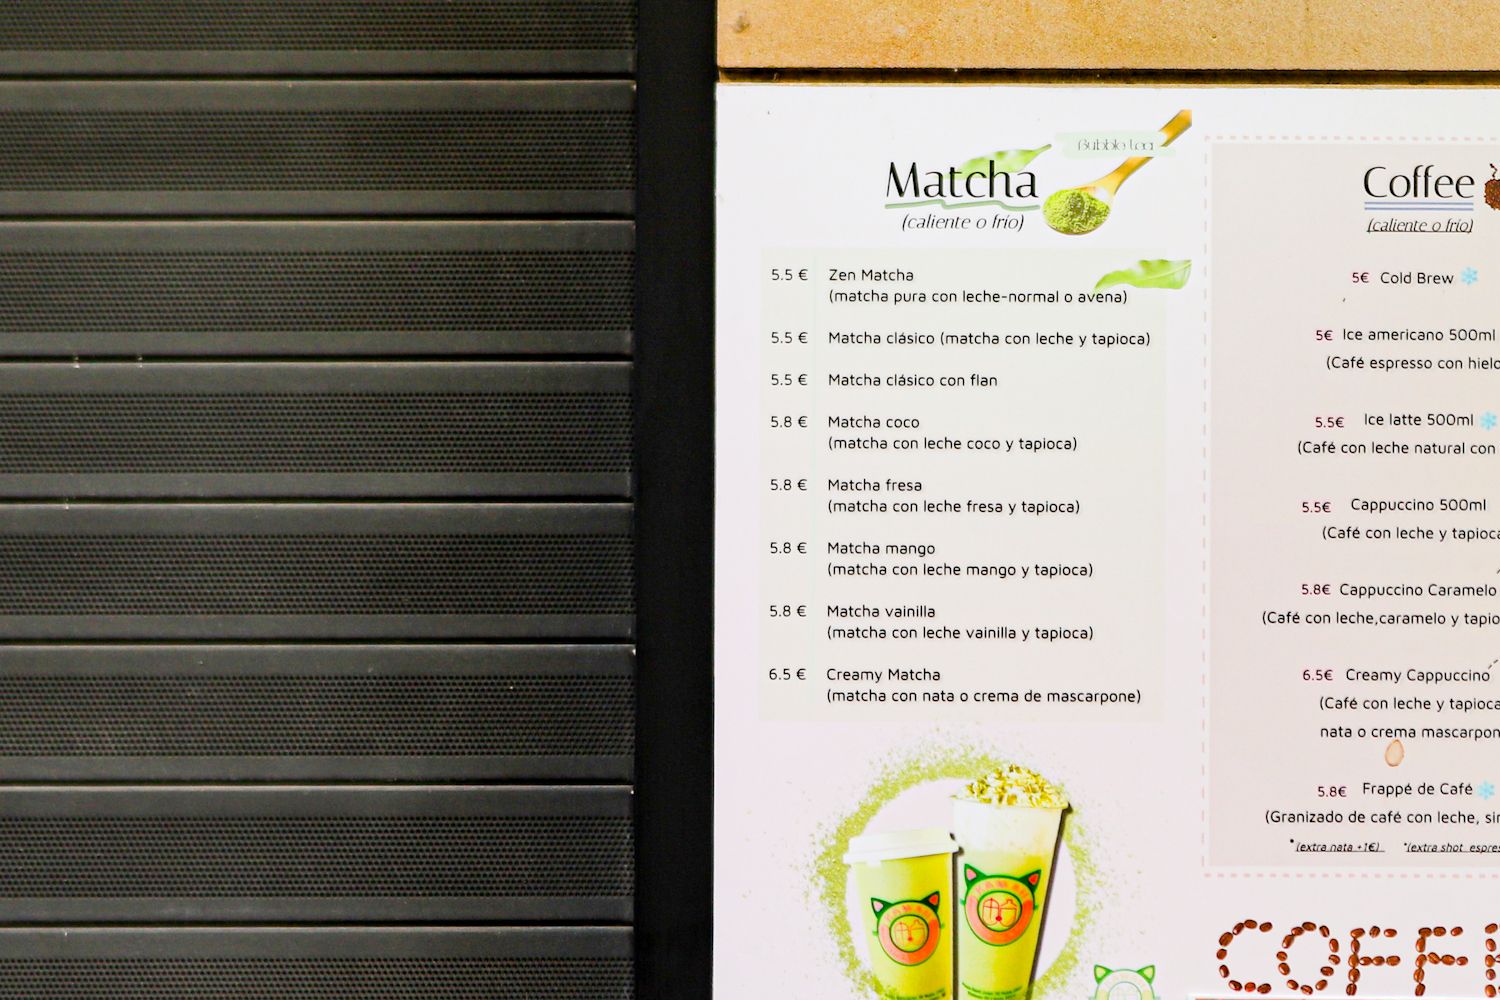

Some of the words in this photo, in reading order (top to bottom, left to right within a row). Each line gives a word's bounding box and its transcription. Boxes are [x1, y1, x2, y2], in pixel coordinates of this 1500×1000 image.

[886, 158, 1039, 199] Matcha
[1363, 164, 1475, 199] Coffee
[902, 213, 971, 232] (caliente
[975, 218, 987, 229] o
[991, 214, 1025, 232] frío)
[1366, 217, 1428, 233] (caliente
[1431, 222, 1442, 232] o
[1444, 217, 1474, 233] frío)
[771, 268, 793, 281] 5.5
[797, 268, 809, 281] €
[829, 268, 856, 282] Zen
[861, 268, 914, 282] Matcha
[1352, 271, 1369, 284] 5€
[1380, 271, 1412, 285] Cold
[1417, 272, 1454, 285] Brew
[829, 289, 889, 303] (matcha
[894, 292, 927, 306] pura
[931, 292, 957, 303] con
[962, 289, 1059, 303] leche-normal
[1064, 293, 1073, 303] o
[1077, 287, 1128, 305] avena)
[771, 331, 793, 344] 5.5
[797, 331, 808, 344] €
[828, 331, 881, 345] Matcha
[886, 331, 935, 345] clásico
[940, 331, 1000, 346] (matcha
[1004, 334, 1031, 345] con
[1036, 331, 1074, 345] leche
[1078, 335, 1087, 348] y
[1091, 332, 1151, 348] tapioca)
[1315, 329, 1333, 341] 5€
[1343, 328, 1363, 341] Ice
[1368, 328, 1444, 341] americano
[1449, 328, 1496, 342] 500ml
[1326, 355, 1365, 371] (Café
[1369, 359, 1433, 373] espresso
[1437, 359, 1463, 370] con
[770, 415, 793, 428] 5.8
[797, 415, 808, 428] €
[828, 415, 881, 429] Matcha
[886, 418, 920, 429] coco
[1315, 416, 1345, 429] 5.5€
[1364, 413, 1385, 426] Ice
[1389, 413, 1422, 426] latte
[1427, 413, 1474, 426] 500ml
[1302, 501, 1331, 513] 5.5€
[1350, 498, 1435, 514] Cappuccino
[1439, 498, 1487, 512] 500ml
[1301, 583, 1331, 596] 5.8€
[1339, 583, 1424, 599] Cappuccino
[1428, 583, 1497, 597] Caramelo
[769, 604, 792, 618] 5.8
[796, 604, 807, 618] €
[827, 604, 880, 618] Matcha
[884, 604, 936, 618] vainilla
[1262, 610, 1301, 625] (Café
[1305, 614, 1331, 625] con
[1336, 611, 1446, 626] leche,caramelo
[1450, 615, 1460, 628] y
[768, 668, 791, 681] 6.5
[796, 668, 807, 681] €
[826, 668, 883, 684] Creamy
[888, 667, 941, 682] Matcha
[1302, 669, 1333, 681] 6.5€
[1345, 668, 1402, 684] Creamy
[1406, 668, 1491, 685] Cappuccino
[827, 688, 887, 704] (matcha
[891, 692, 917, 703] con
[922, 690, 955, 703] nata
[959, 692, 969, 703] o
[973, 692, 1019, 703] crema
[1024, 689, 1042, 703] de
[1047, 689, 1141, 706] mascarpone)
[1317, 785, 1347, 798] 5.8€
[1362, 782, 1413, 798] Frappé
[1417, 782, 1435, 795] de
[1439, 782, 1473, 796] Café
